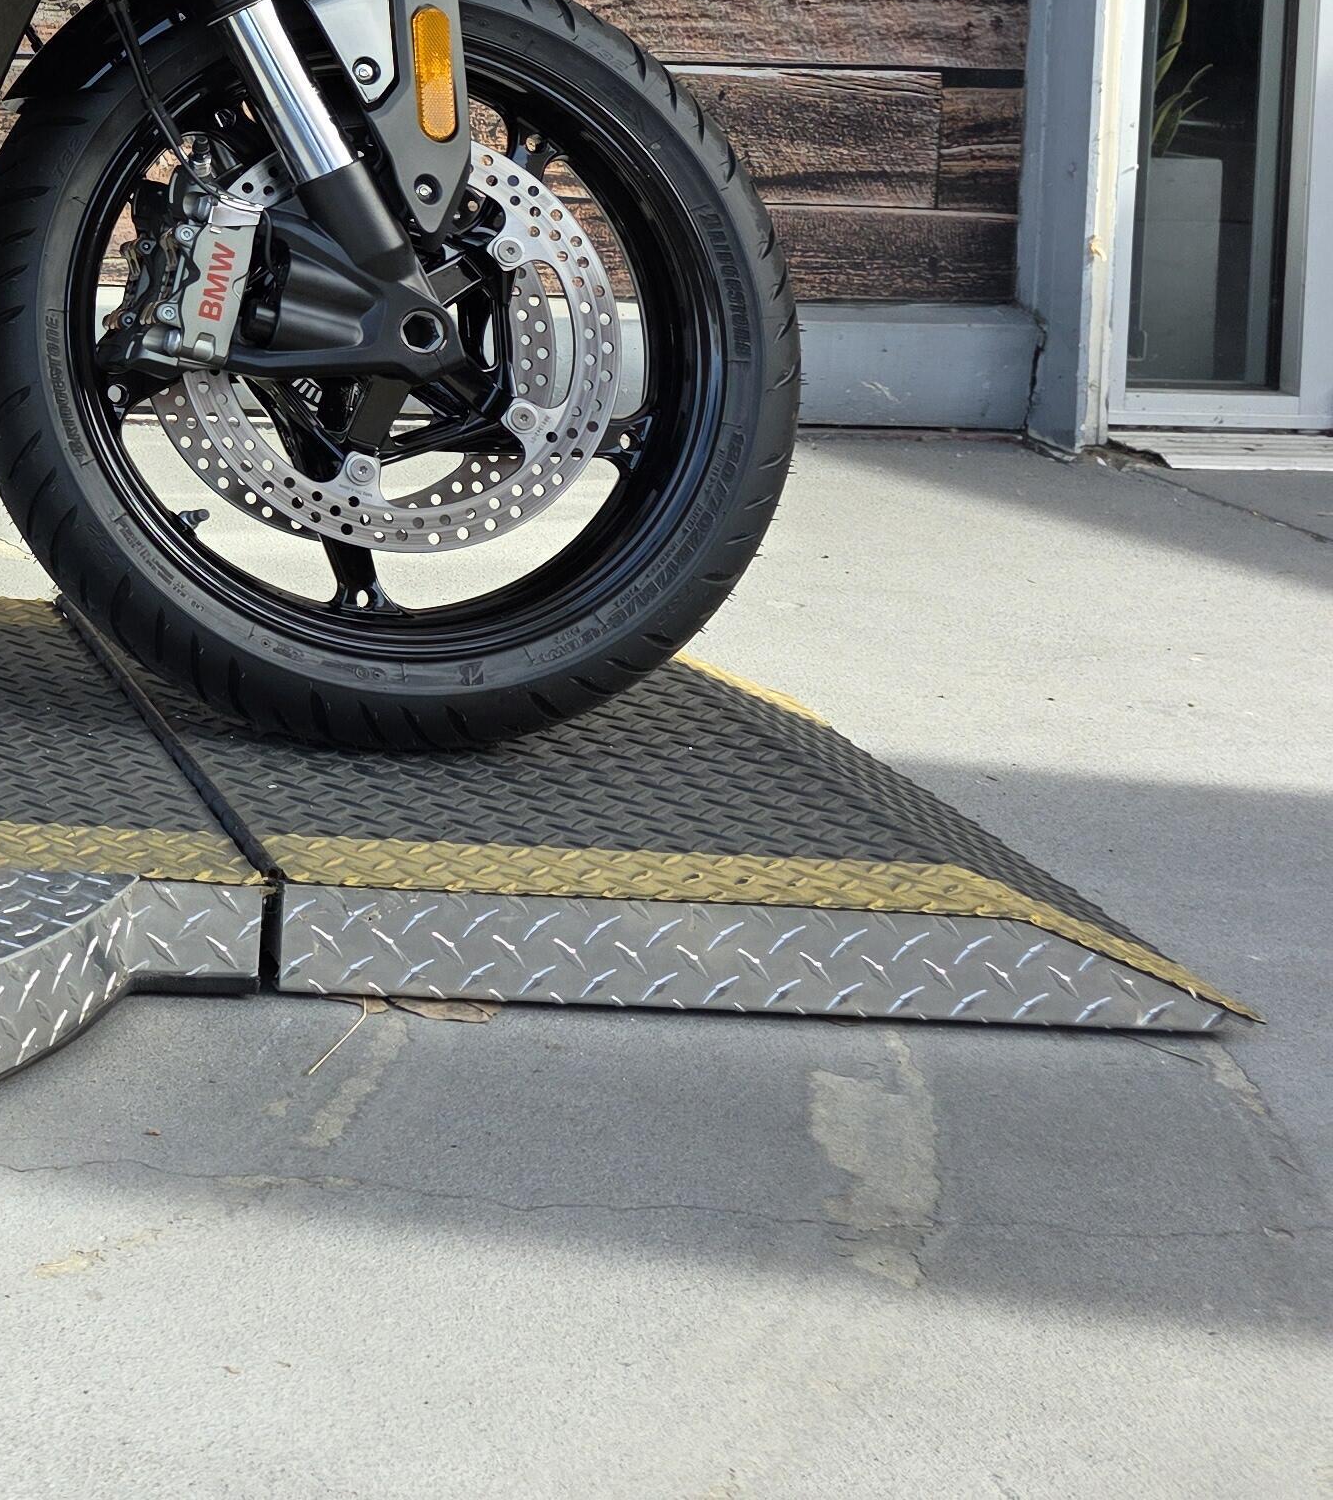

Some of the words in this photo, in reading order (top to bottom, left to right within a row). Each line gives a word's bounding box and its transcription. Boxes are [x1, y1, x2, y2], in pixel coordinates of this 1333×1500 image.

[197, 241, 237, 322] BMW
[697, 212, 752, 359] BRIDGESTONE
[44, 311, 89, 468] BRIDGESTONE
